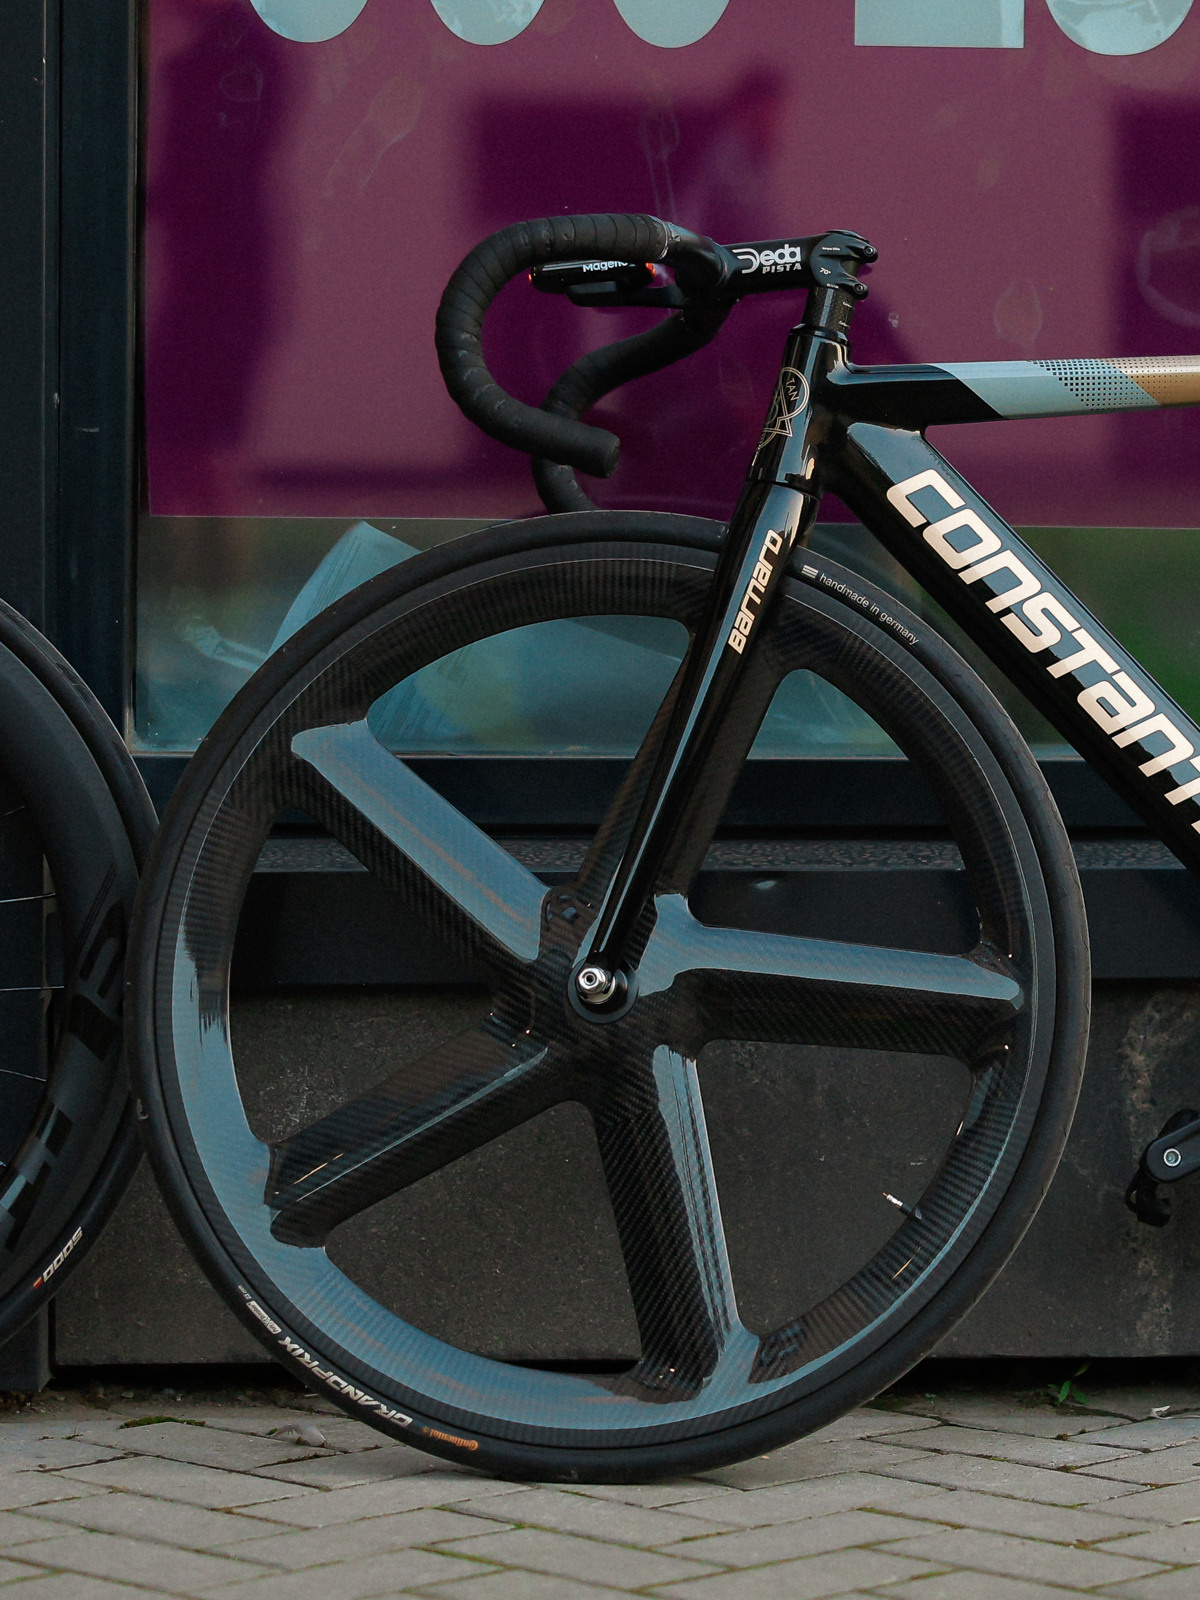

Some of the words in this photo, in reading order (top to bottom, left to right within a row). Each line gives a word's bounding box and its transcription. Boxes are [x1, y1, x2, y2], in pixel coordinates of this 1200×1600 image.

[762, 262, 802, 275] PISTA
[819, 572, 870, 608] handmade
[869, 603, 880, 615] in
[879, 611, 920, 646] germany
[43, 1225, 83, 1283] 5000
